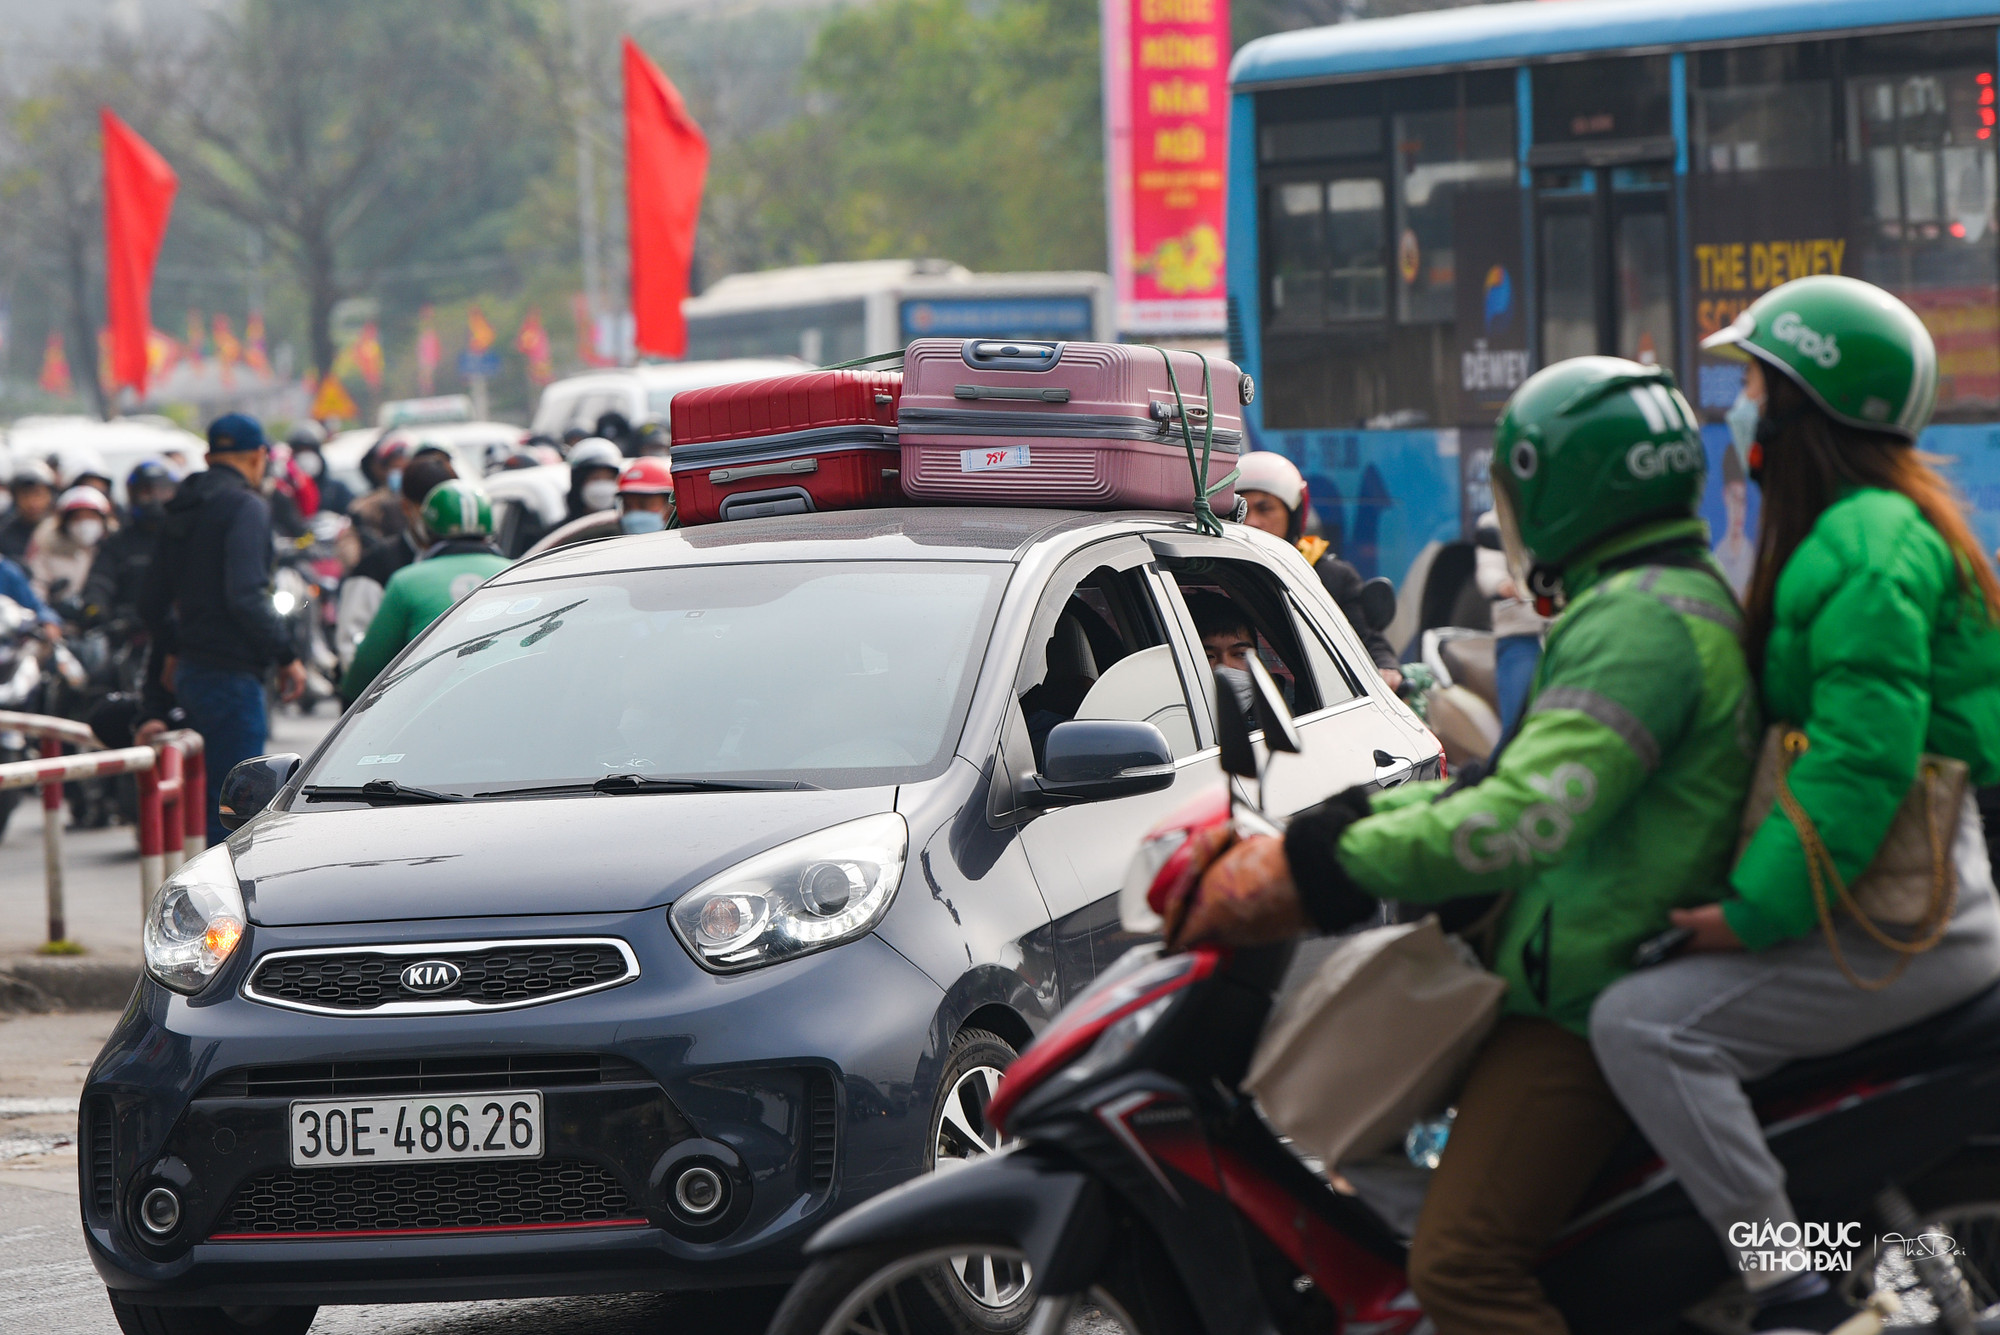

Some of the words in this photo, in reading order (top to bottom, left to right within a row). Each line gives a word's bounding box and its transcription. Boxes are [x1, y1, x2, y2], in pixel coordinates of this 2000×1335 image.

[1697, 244, 1746, 291] THE
[1751, 238, 1845, 290] DEWEY
[1771, 310, 1841, 370] Grab
[1453, 761, 1599, 874] Grab
[409, 966, 450, 986] KIA
[299, 1101, 533, 1158] 30E-486.26
